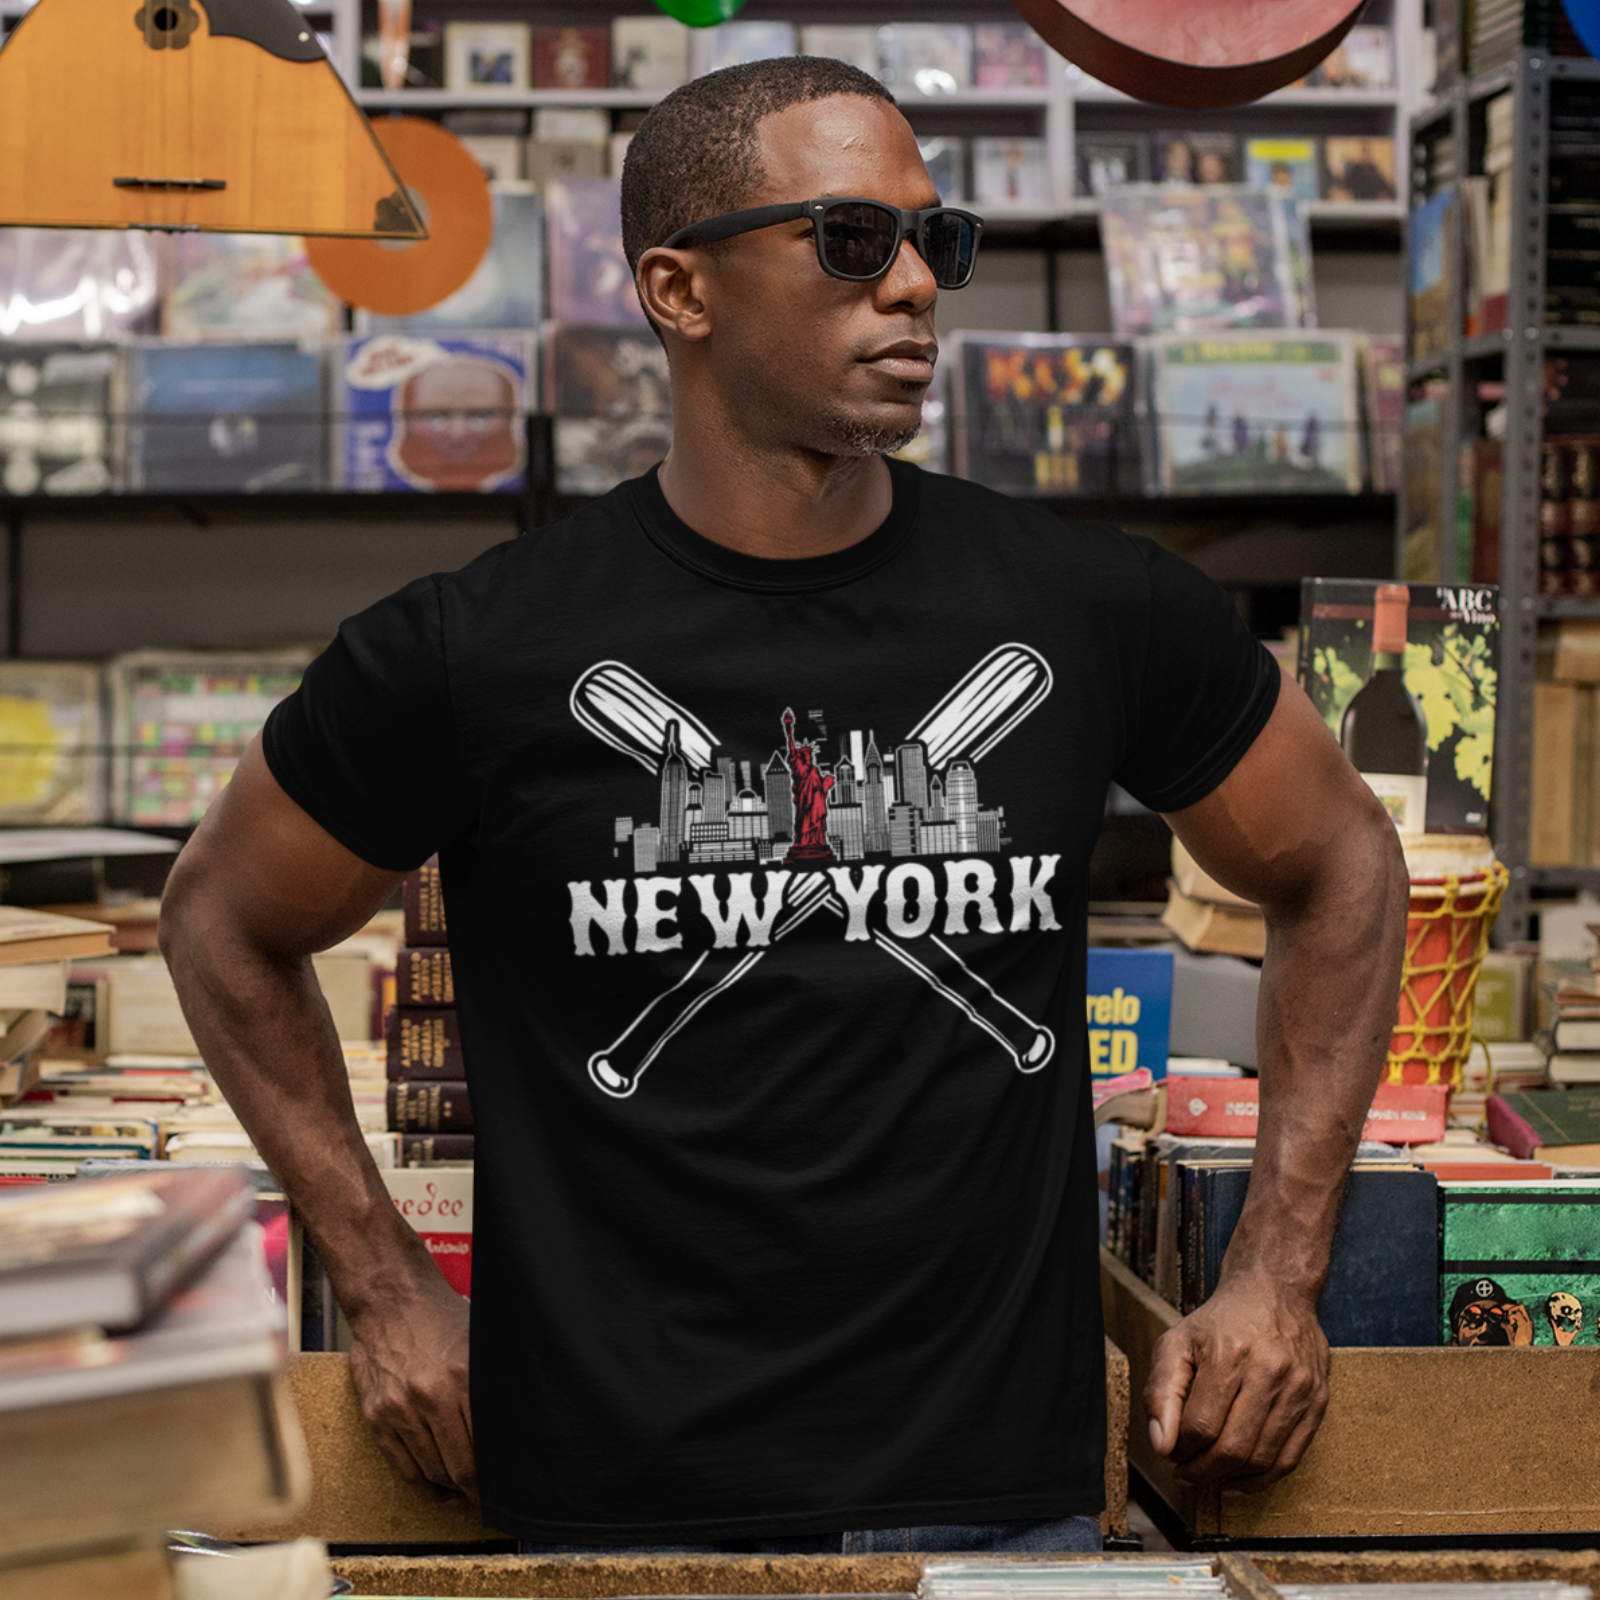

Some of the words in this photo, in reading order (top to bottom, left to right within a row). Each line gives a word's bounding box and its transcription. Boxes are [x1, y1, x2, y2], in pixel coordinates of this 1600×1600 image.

[567, 870, 792, 957] NEW
[827, 853, 1063, 942] YORK
[410, 951, 422, 1002] AMADO
[401, 1018, 412, 1068] AMADO
